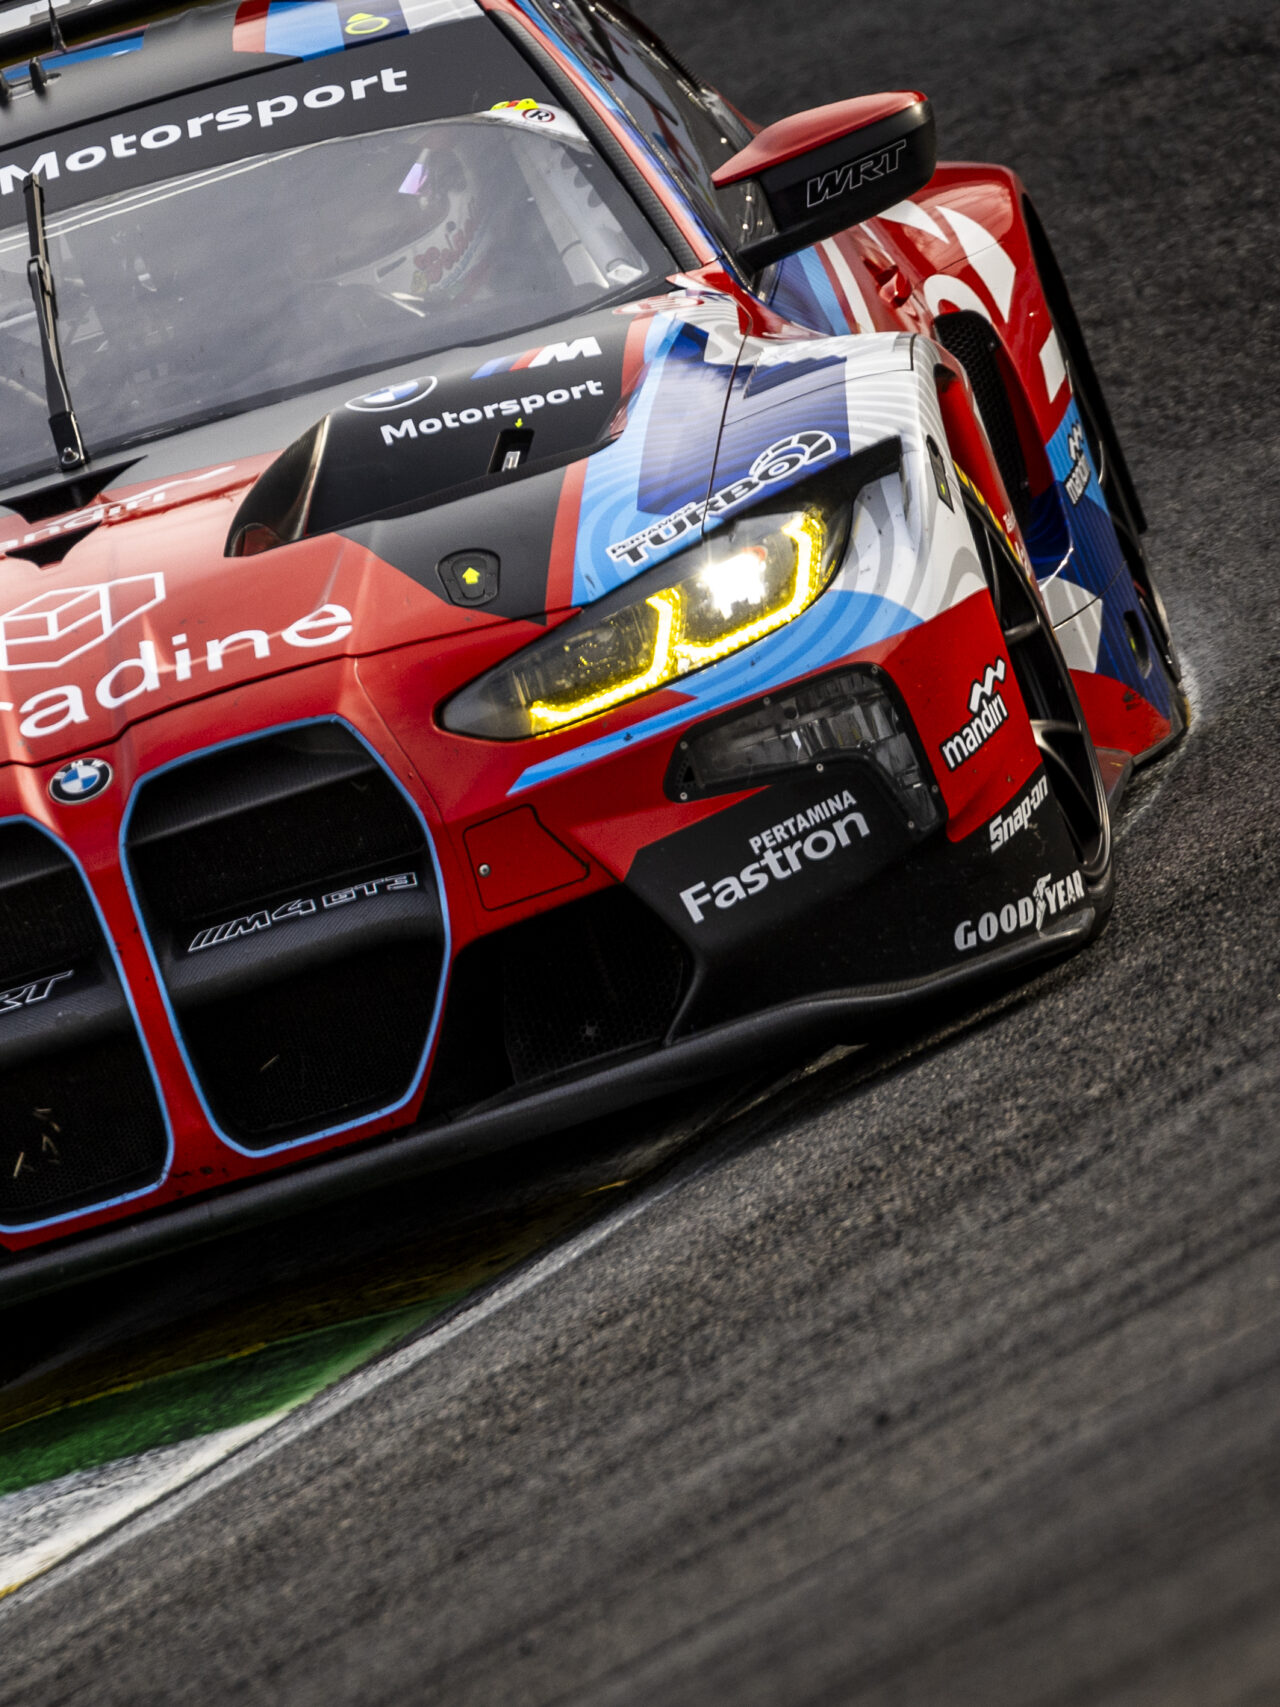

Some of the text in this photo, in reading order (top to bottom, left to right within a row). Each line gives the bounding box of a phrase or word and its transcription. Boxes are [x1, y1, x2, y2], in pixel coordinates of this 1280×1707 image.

[807, 139, 907, 208] WRT
[380, 380, 604, 446] Motorsport
[942, 693, 1009, 769] mandiri
[749, 790, 857, 855] PERTAMINA
[989, 775, 1049, 853] Snap-on
[322, 871, 418, 909] GT3
[679, 811, 870, 924] Fastron
